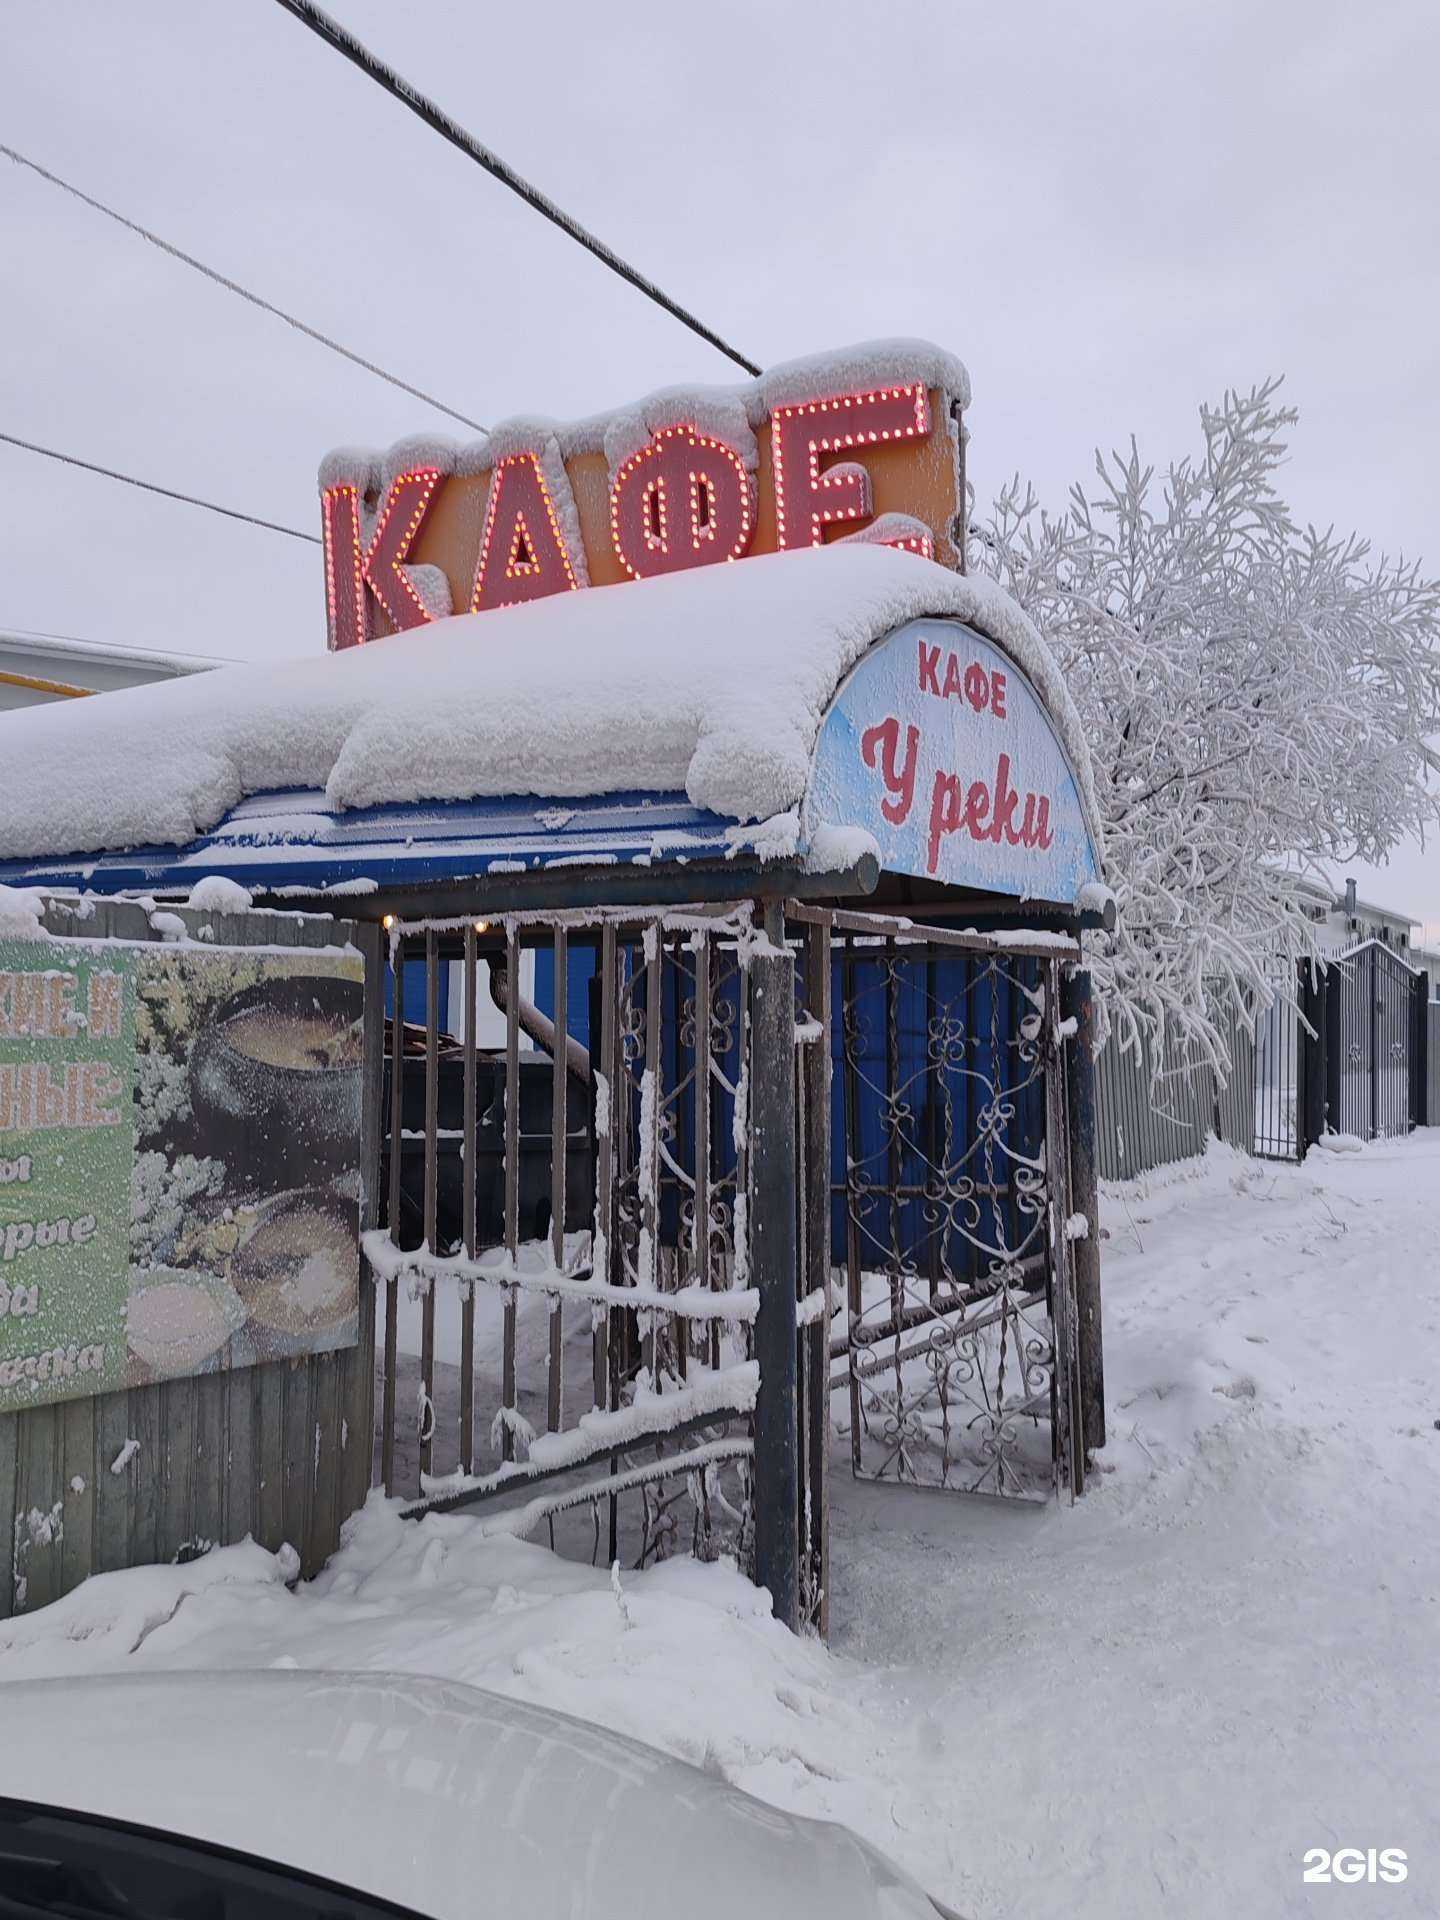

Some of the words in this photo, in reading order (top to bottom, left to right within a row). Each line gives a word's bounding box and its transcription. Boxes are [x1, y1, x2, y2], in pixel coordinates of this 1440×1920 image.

[321, 380, 935, 652] КАФЕ
[918, 639, 1007, 719] КАФЕ
[861, 717, 920, 826] У
[927, 753, 1055, 874] реки
[0, 1214, 97, 1260] рые
